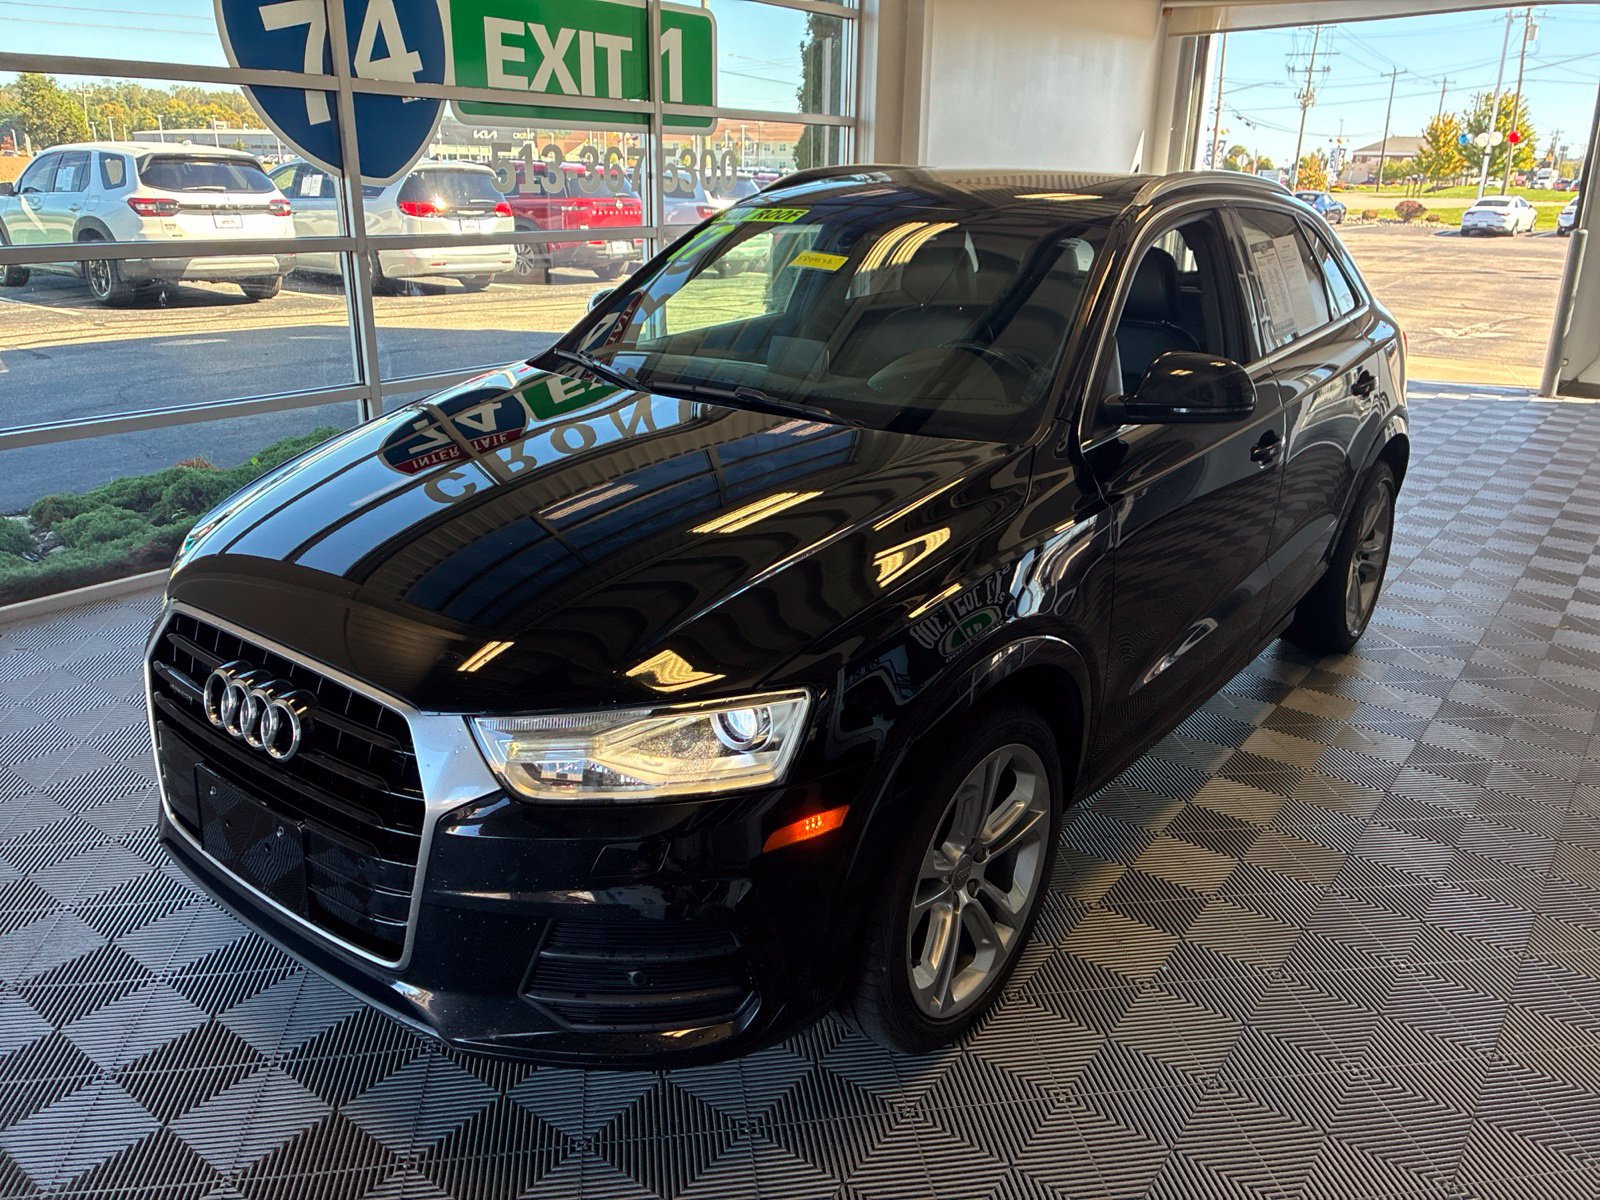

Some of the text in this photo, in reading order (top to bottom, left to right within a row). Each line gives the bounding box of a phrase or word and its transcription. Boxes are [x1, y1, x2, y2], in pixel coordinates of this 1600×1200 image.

[258, 0, 423, 126] 74
[483, 16, 683, 103] EXIT 1
[489, 142, 737, 194] 513-3675300
[751, 208, 807, 221] ROOF
